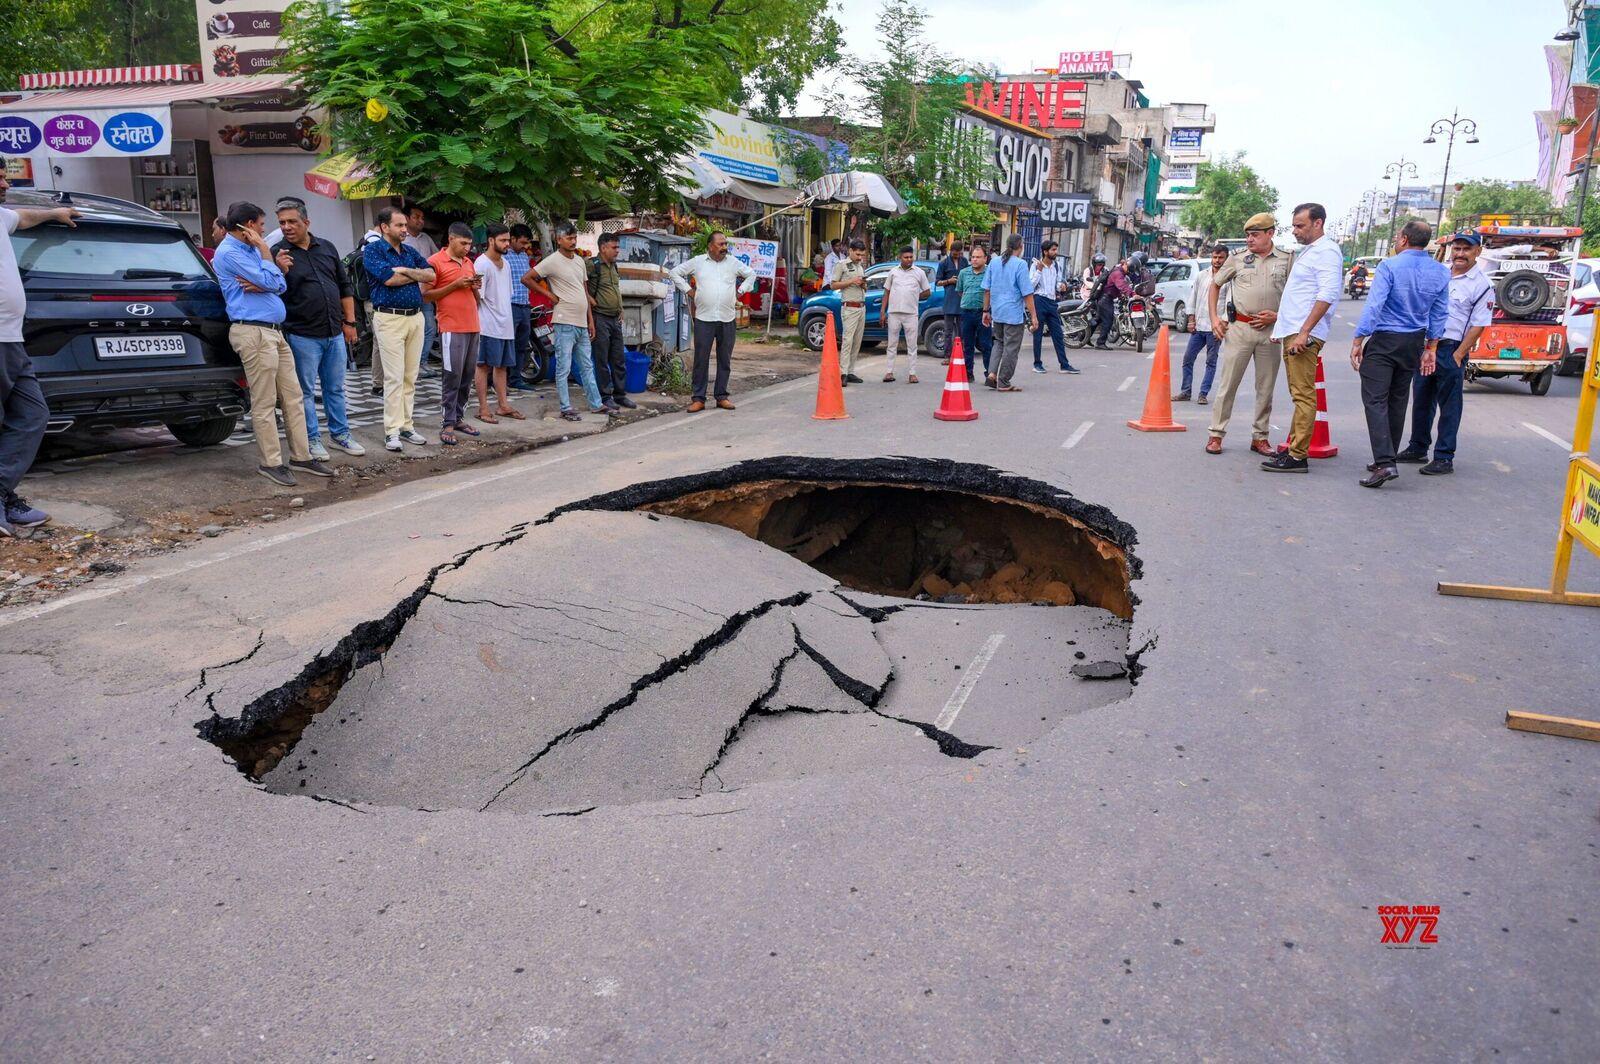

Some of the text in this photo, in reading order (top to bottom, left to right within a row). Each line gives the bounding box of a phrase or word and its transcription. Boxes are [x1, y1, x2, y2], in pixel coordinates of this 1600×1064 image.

[252, 19, 271, 29] Cafe
[250, 57, 279, 68] Gifting
[1061, 52, 1110, 63] HOTEL
[1060, 62, 1110, 74] ANANTA
[964, 81, 1085, 128] WINE
[56, 118, 75, 131] केसर
[110, 121, 155, 145] स्नैक्स
[249, 131, 287, 140] Fine Dine
[65, 135, 76, 146] की
[77, 136, 93, 146] चाय
[997, 135, 1052, 201] SHOP
[350, 183, 372, 194] STUDY
[1040, 198, 1090, 222] शराब
[105, 338, 183, 354] RJ45CP9398
